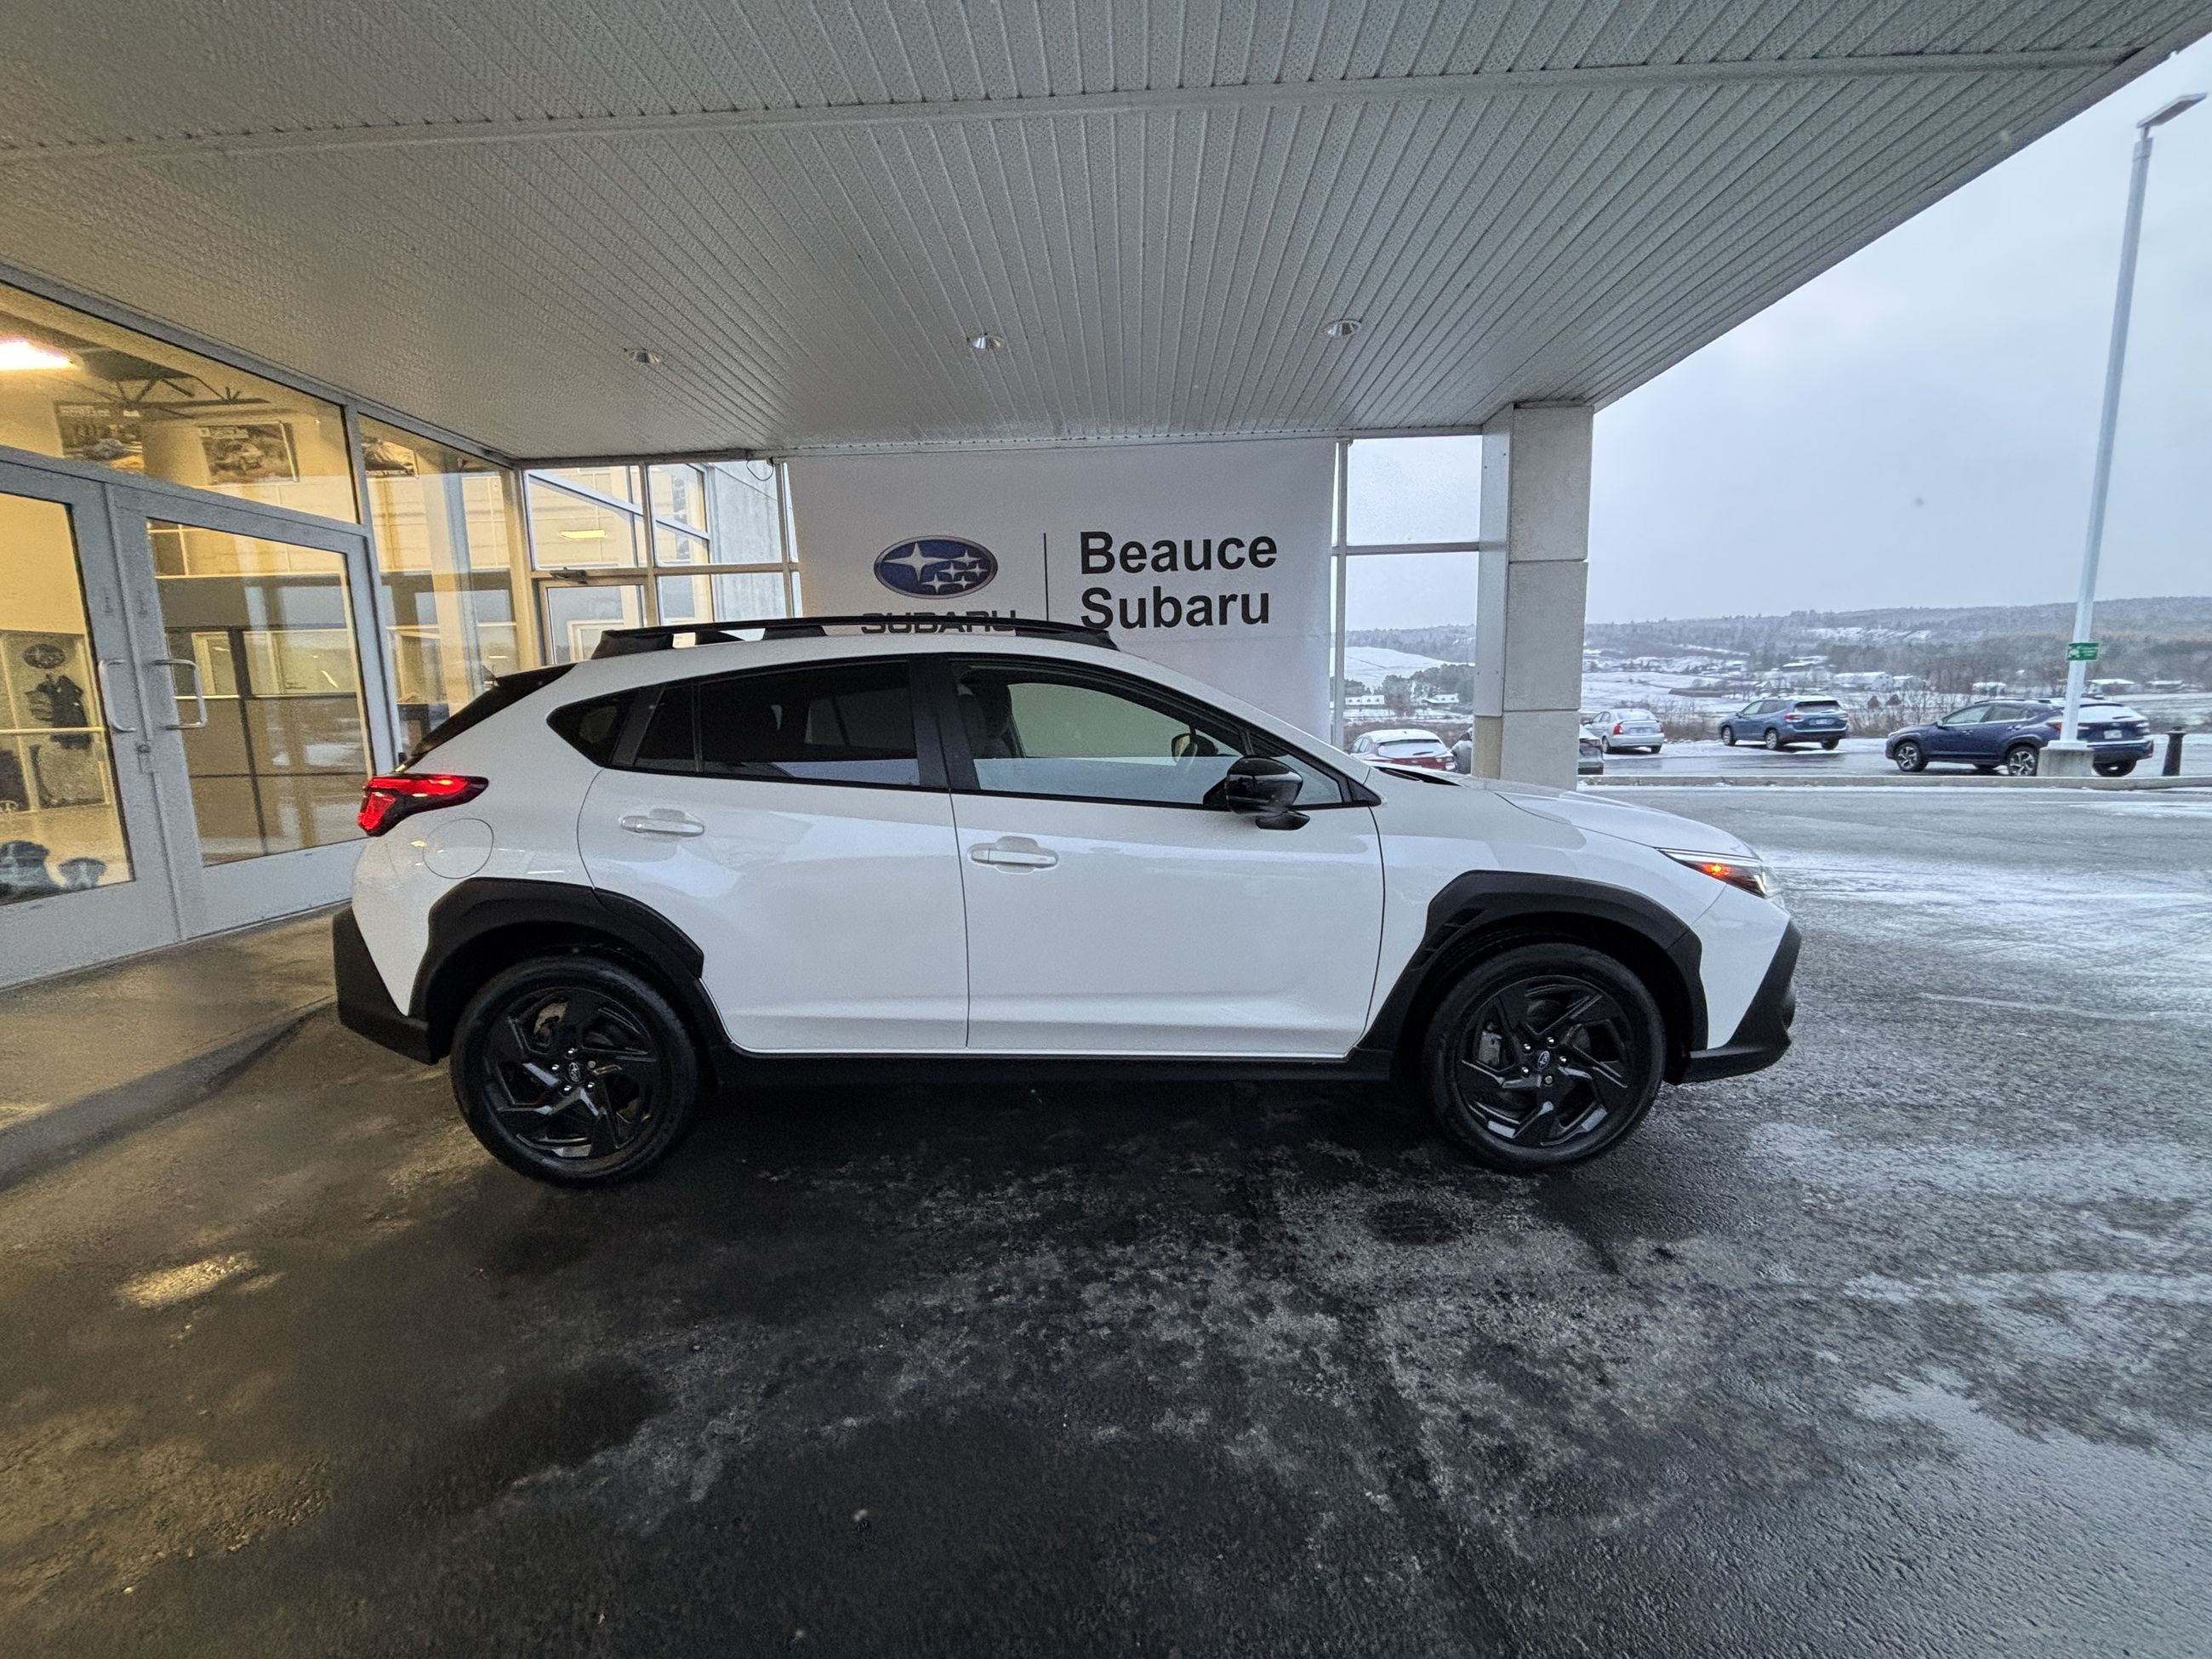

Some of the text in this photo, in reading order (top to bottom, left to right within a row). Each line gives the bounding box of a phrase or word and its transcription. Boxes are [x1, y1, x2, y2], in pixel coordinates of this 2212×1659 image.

[1080, 531, 1277, 575] Beauce
[860, 609, 1017, 634] SUBARU
[1080, 585, 1269, 630] Subaru
